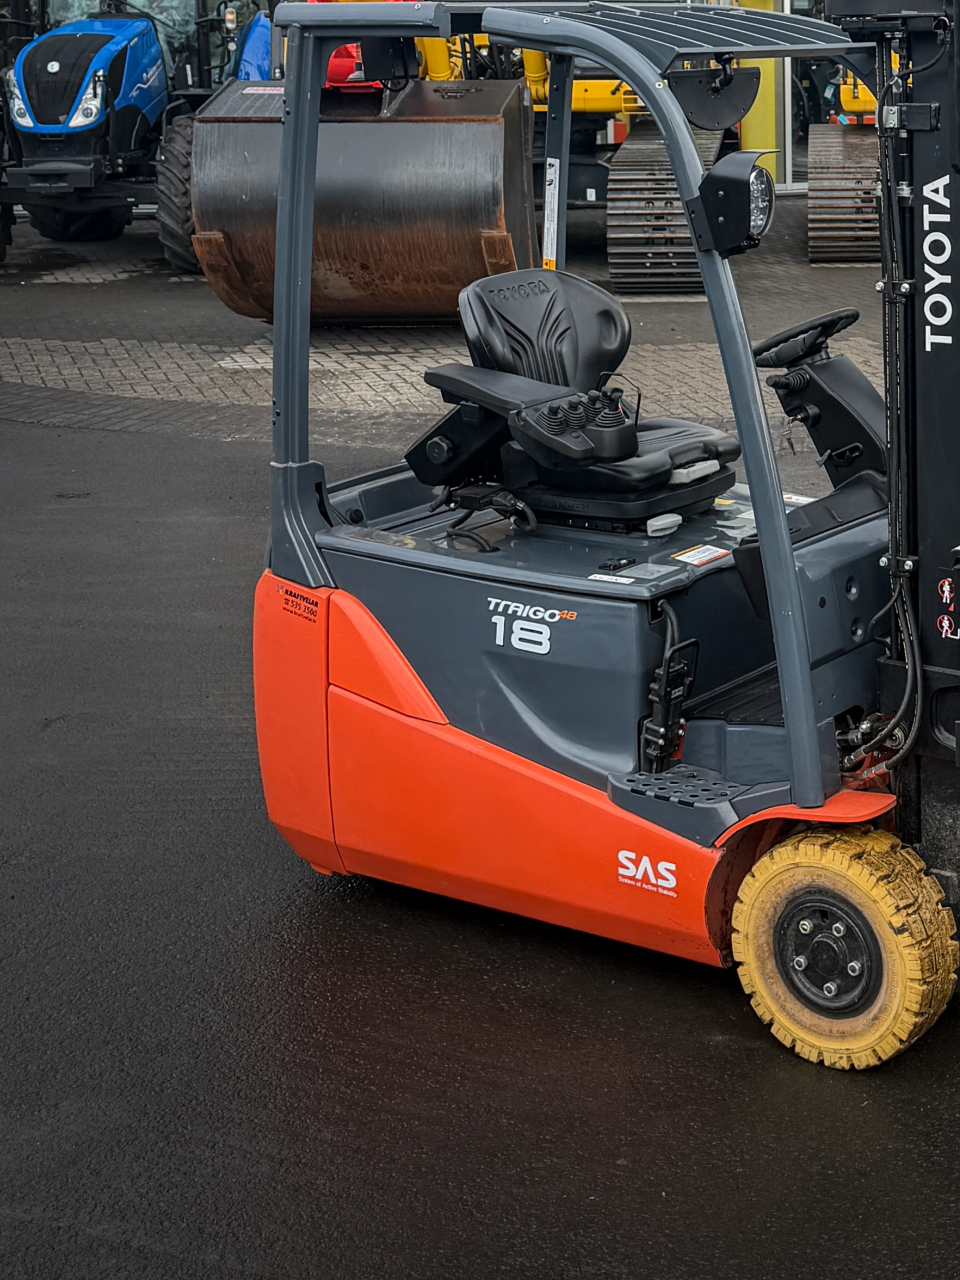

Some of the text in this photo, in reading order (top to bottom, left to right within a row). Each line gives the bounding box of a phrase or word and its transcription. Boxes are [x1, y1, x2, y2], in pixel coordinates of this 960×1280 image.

[923, 174, 953, 351] TOYOTA
[488, 279, 550, 301] TOYOTA
[491, 615, 551, 654] 18
[618, 850, 677, 888] SAS
